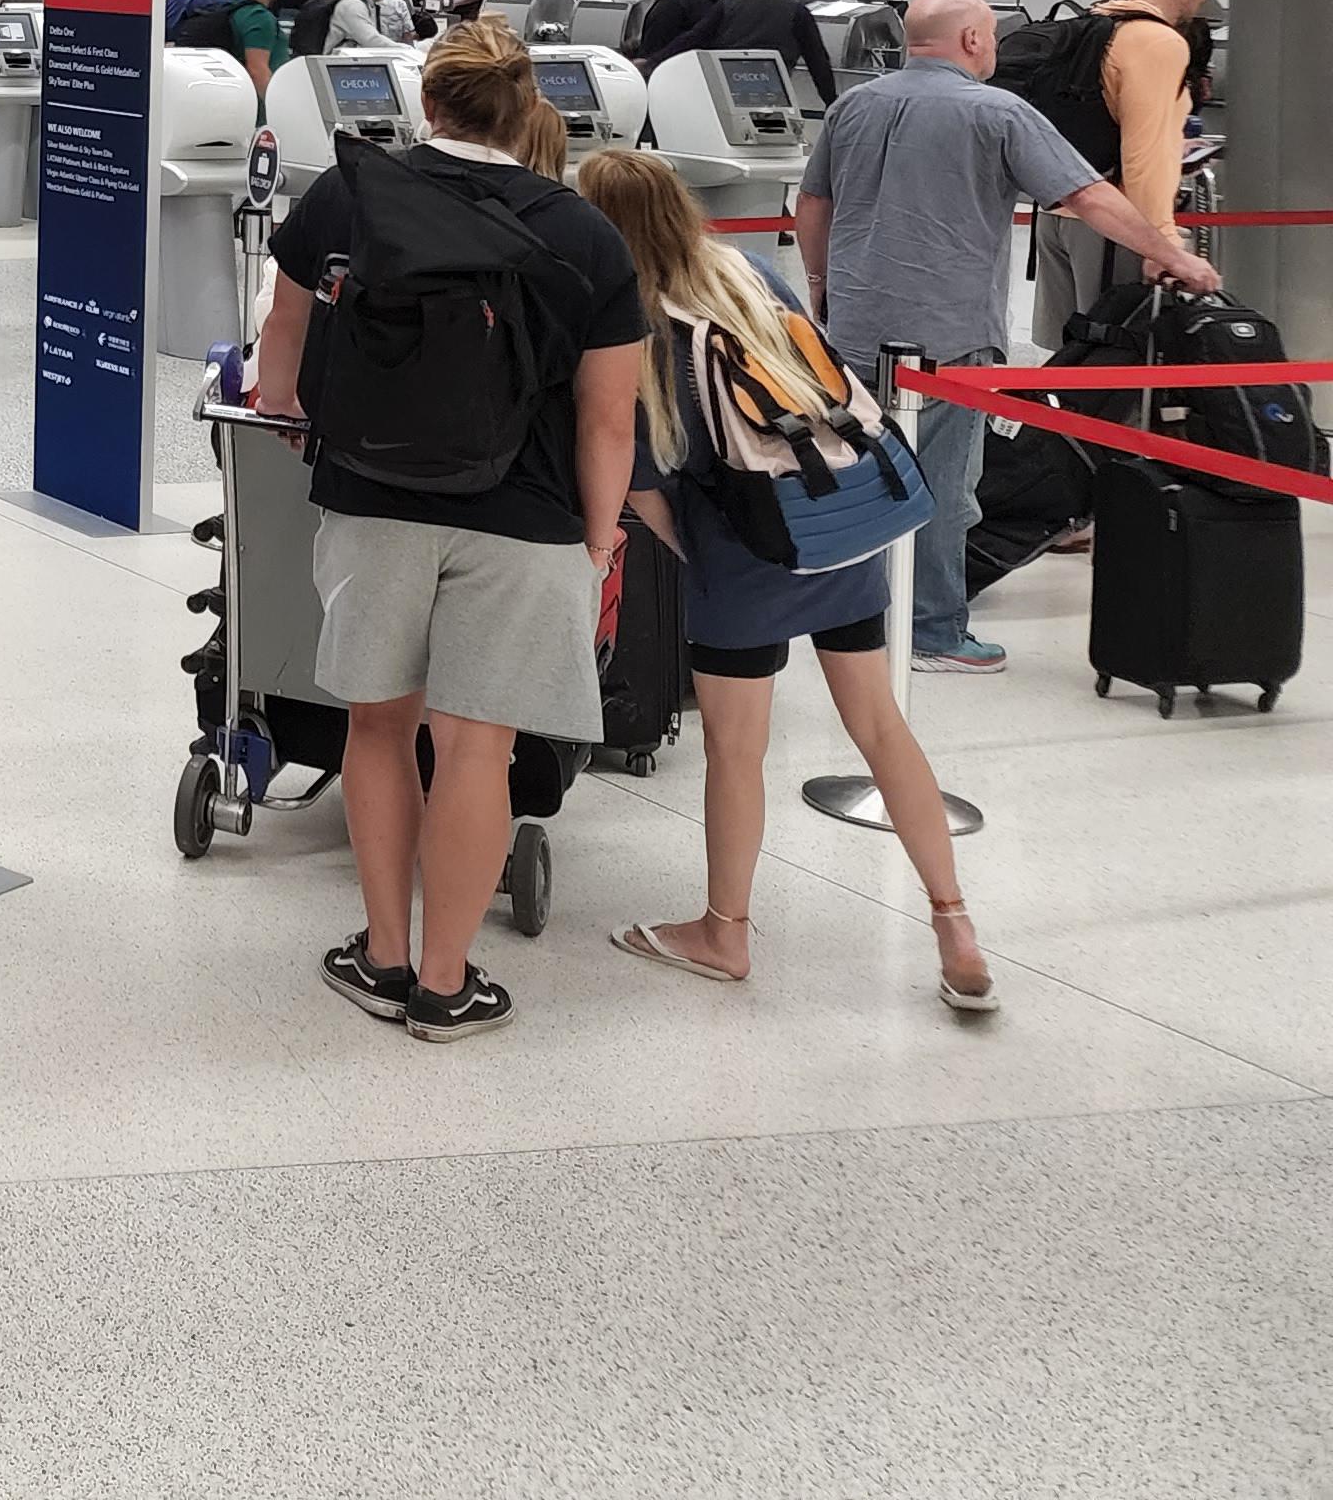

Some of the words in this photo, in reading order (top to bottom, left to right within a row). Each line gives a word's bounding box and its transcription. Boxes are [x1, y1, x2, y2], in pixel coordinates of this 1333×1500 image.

[49, 25, 63, 36] Delta
[92, 47, 104, 57] First
[104, 48, 119, 59] Class
[100, 65, 114, 75] Gold
[340, 79, 370, 89] CHECK
[370, 79, 380, 88] IN
[539, 75, 567, 85] CHECK
[58, 125, 72, 135] ALSO
[49, 345, 74, 361] LATAM
